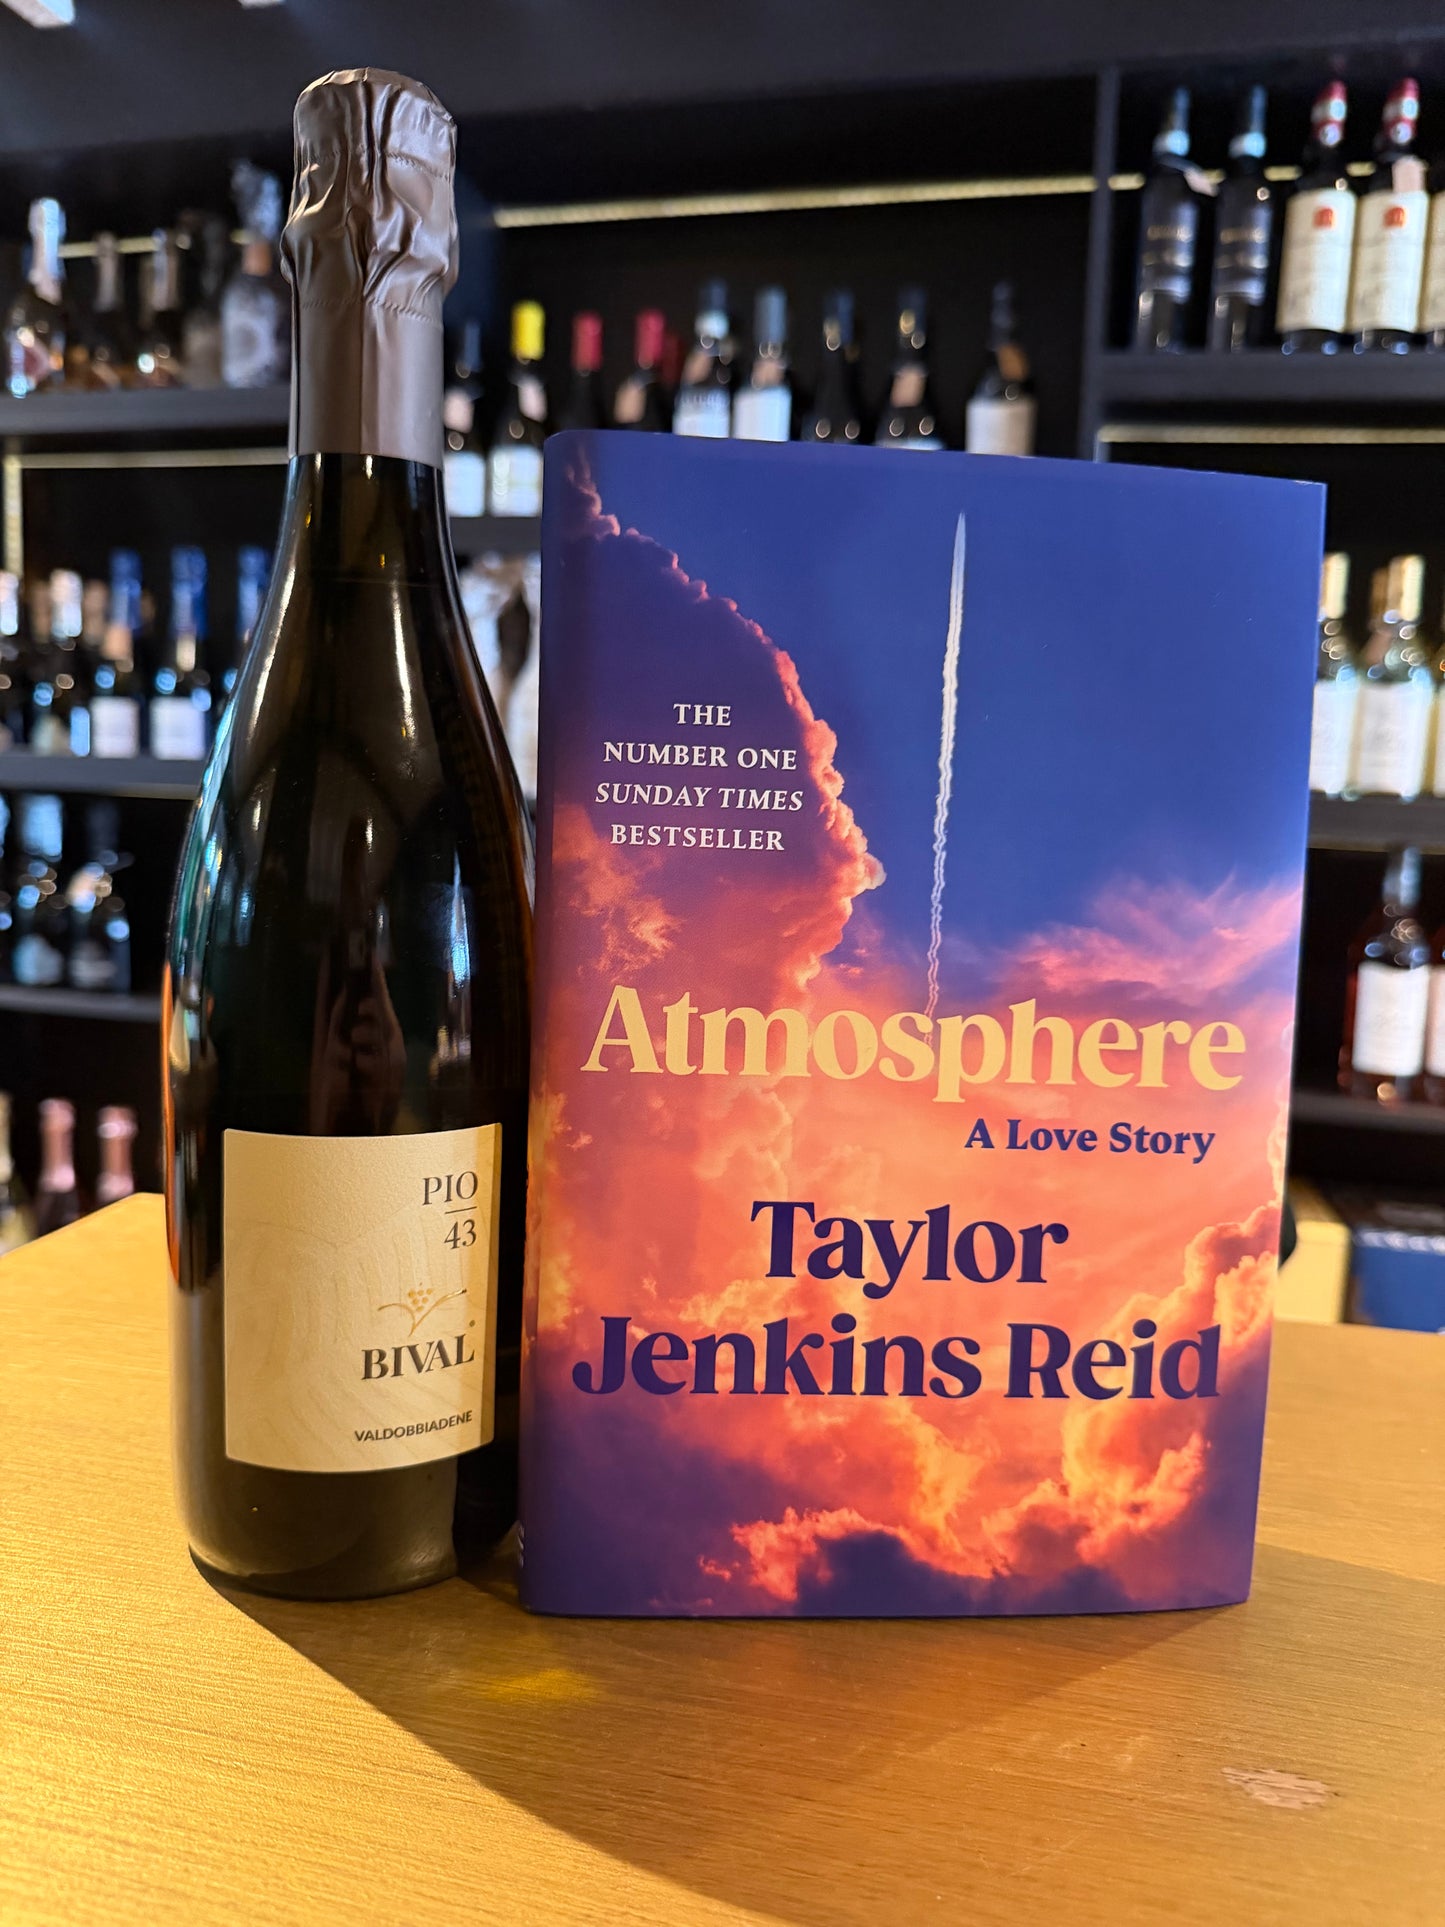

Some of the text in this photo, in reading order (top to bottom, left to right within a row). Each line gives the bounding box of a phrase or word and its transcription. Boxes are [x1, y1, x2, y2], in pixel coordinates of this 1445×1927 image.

[673, 703, 731, 726] THE
[603, 742, 797, 770] NUMBER ONE
[595, 783, 803, 811] SUNDAY TIMES
[610, 824, 784, 850] BESTSELLER
[581, 985, 1246, 1103] Atmosphere
[964, 1118, 1215, 1164] A Love Story
[422, 1171, 478, 1206] PIO
[444, 1219, 477, 1250] 43
[750, 1200, 1068, 1299] Taylor
[361, 1334, 475, 1381] BIVAL
[572, 1312, 1221, 1400] Jenkins Reid
[354, 1410, 473, 1442] VALDOBBIADENE
